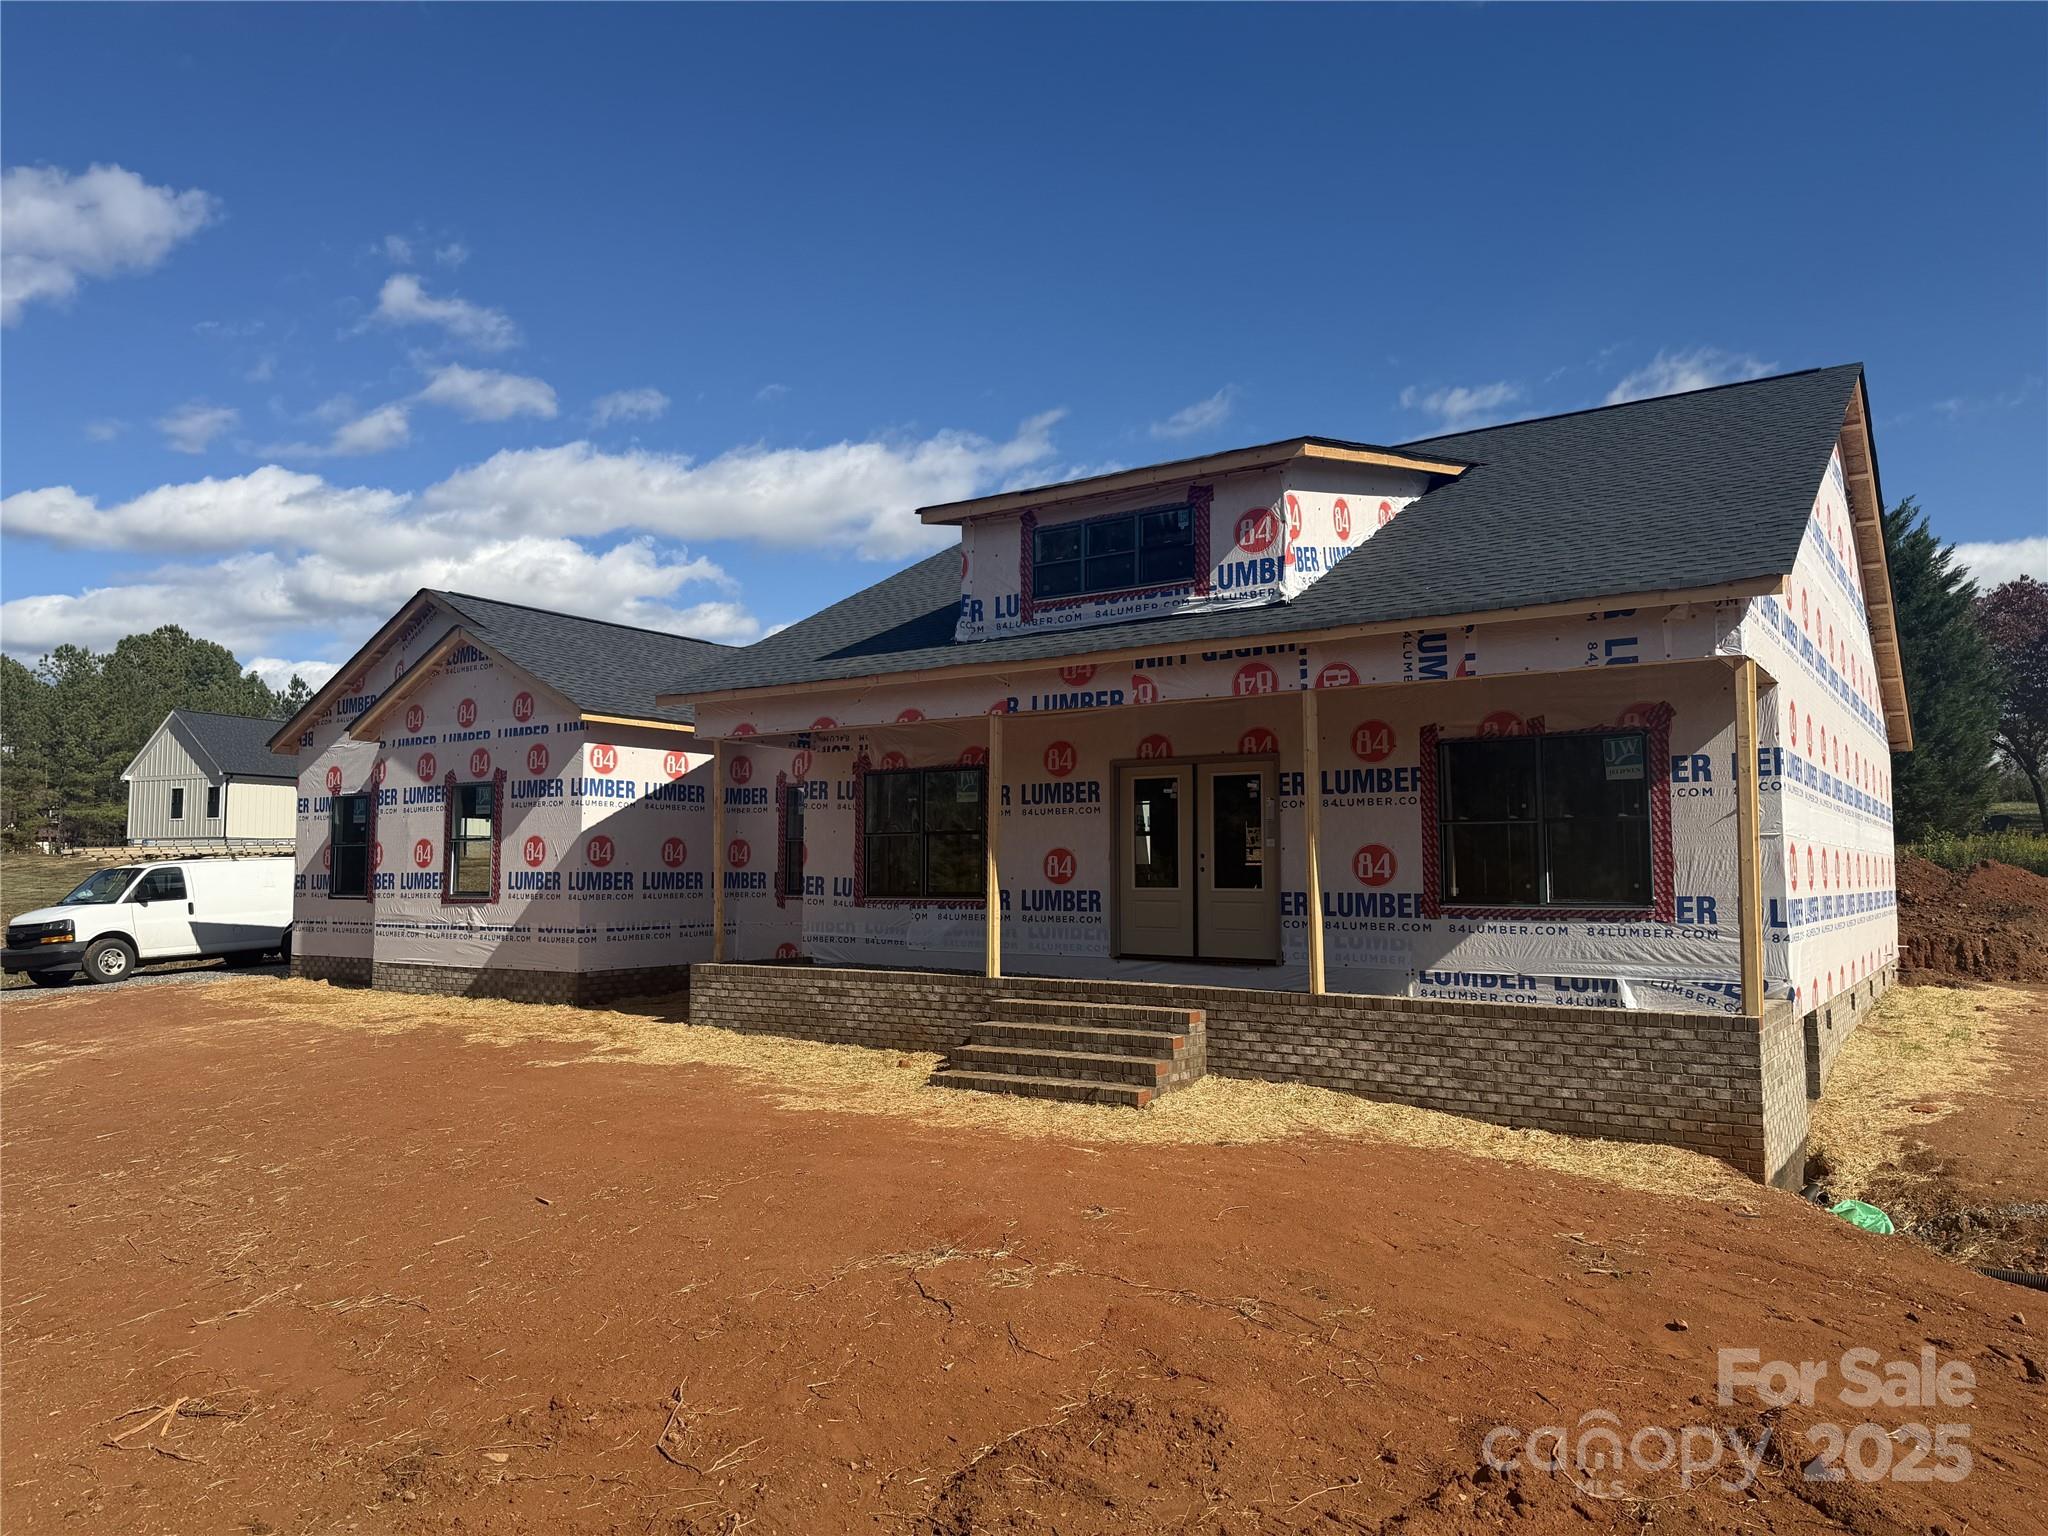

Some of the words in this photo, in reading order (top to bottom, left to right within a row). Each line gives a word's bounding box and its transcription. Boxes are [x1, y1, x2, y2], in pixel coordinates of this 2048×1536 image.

[1238, 515, 1278, 548] 84
[1334, 505, 1350, 533] 84
[406, 709, 425, 729] 84
[458, 705, 476, 724] 84
[514, 696, 532, 718] 84
[1355, 728, 1390, 755] 84
[417, 758, 436, 777] 84
[470, 754, 490, 772] 84
[528, 751, 549, 769] 84
[590, 748, 616, 769] 84
[665, 756, 688, 774] 84
[731, 762, 750, 779] 84
[1046, 747, 1073, 771] 84
[1671, 754, 1713, 784] ER
[511, 778, 564, 800] LUMBER
[571, 778, 636, 800] LUMBER
[644, 781, 705, 804] LUMBER
[1021, 780, 1101, 806] LUMBER
[571, 799, 636, 810] 84LUMBER.COM
[644, 803, 706, 813] 84LUMBER.COM
[1021, 806, 1102, 817] 84LUMBER.COM
[414, 844, 433, 862] 84
[526, 842, 544, 862] 84
[589, 841, 613, 862] 84
[664, 843, 684, 862] 84
[731, 844, 749, 862] 84
[1047, 855, 1073, 878] 84
[1356, 852, 1392, 879] 84
[508, 871, 561, 891] LUMBER
[568, 871, 634, 891] LUMBER
[642, 871, 704, 891] LUMBER
[507, 893, 561, 901] 84LUMBER.COM
[568, 893, 634, 901] 84LUMBER.COM
[1020, 889, 1102, 913] LUMBER
[1676, 895, 1718, 925] ER
[1021, 914, 1103, 925] 84LUMBER.COM
[1324, 920, 1433, 933] 84LUMBER.COM
[1448, 923, 1569, 937] 84LUMBER.COM
[1586, 926, 1720, 941] 84LUMBER.COM
[1420, 988, 1538, 1005] 84LUMBER.COM
